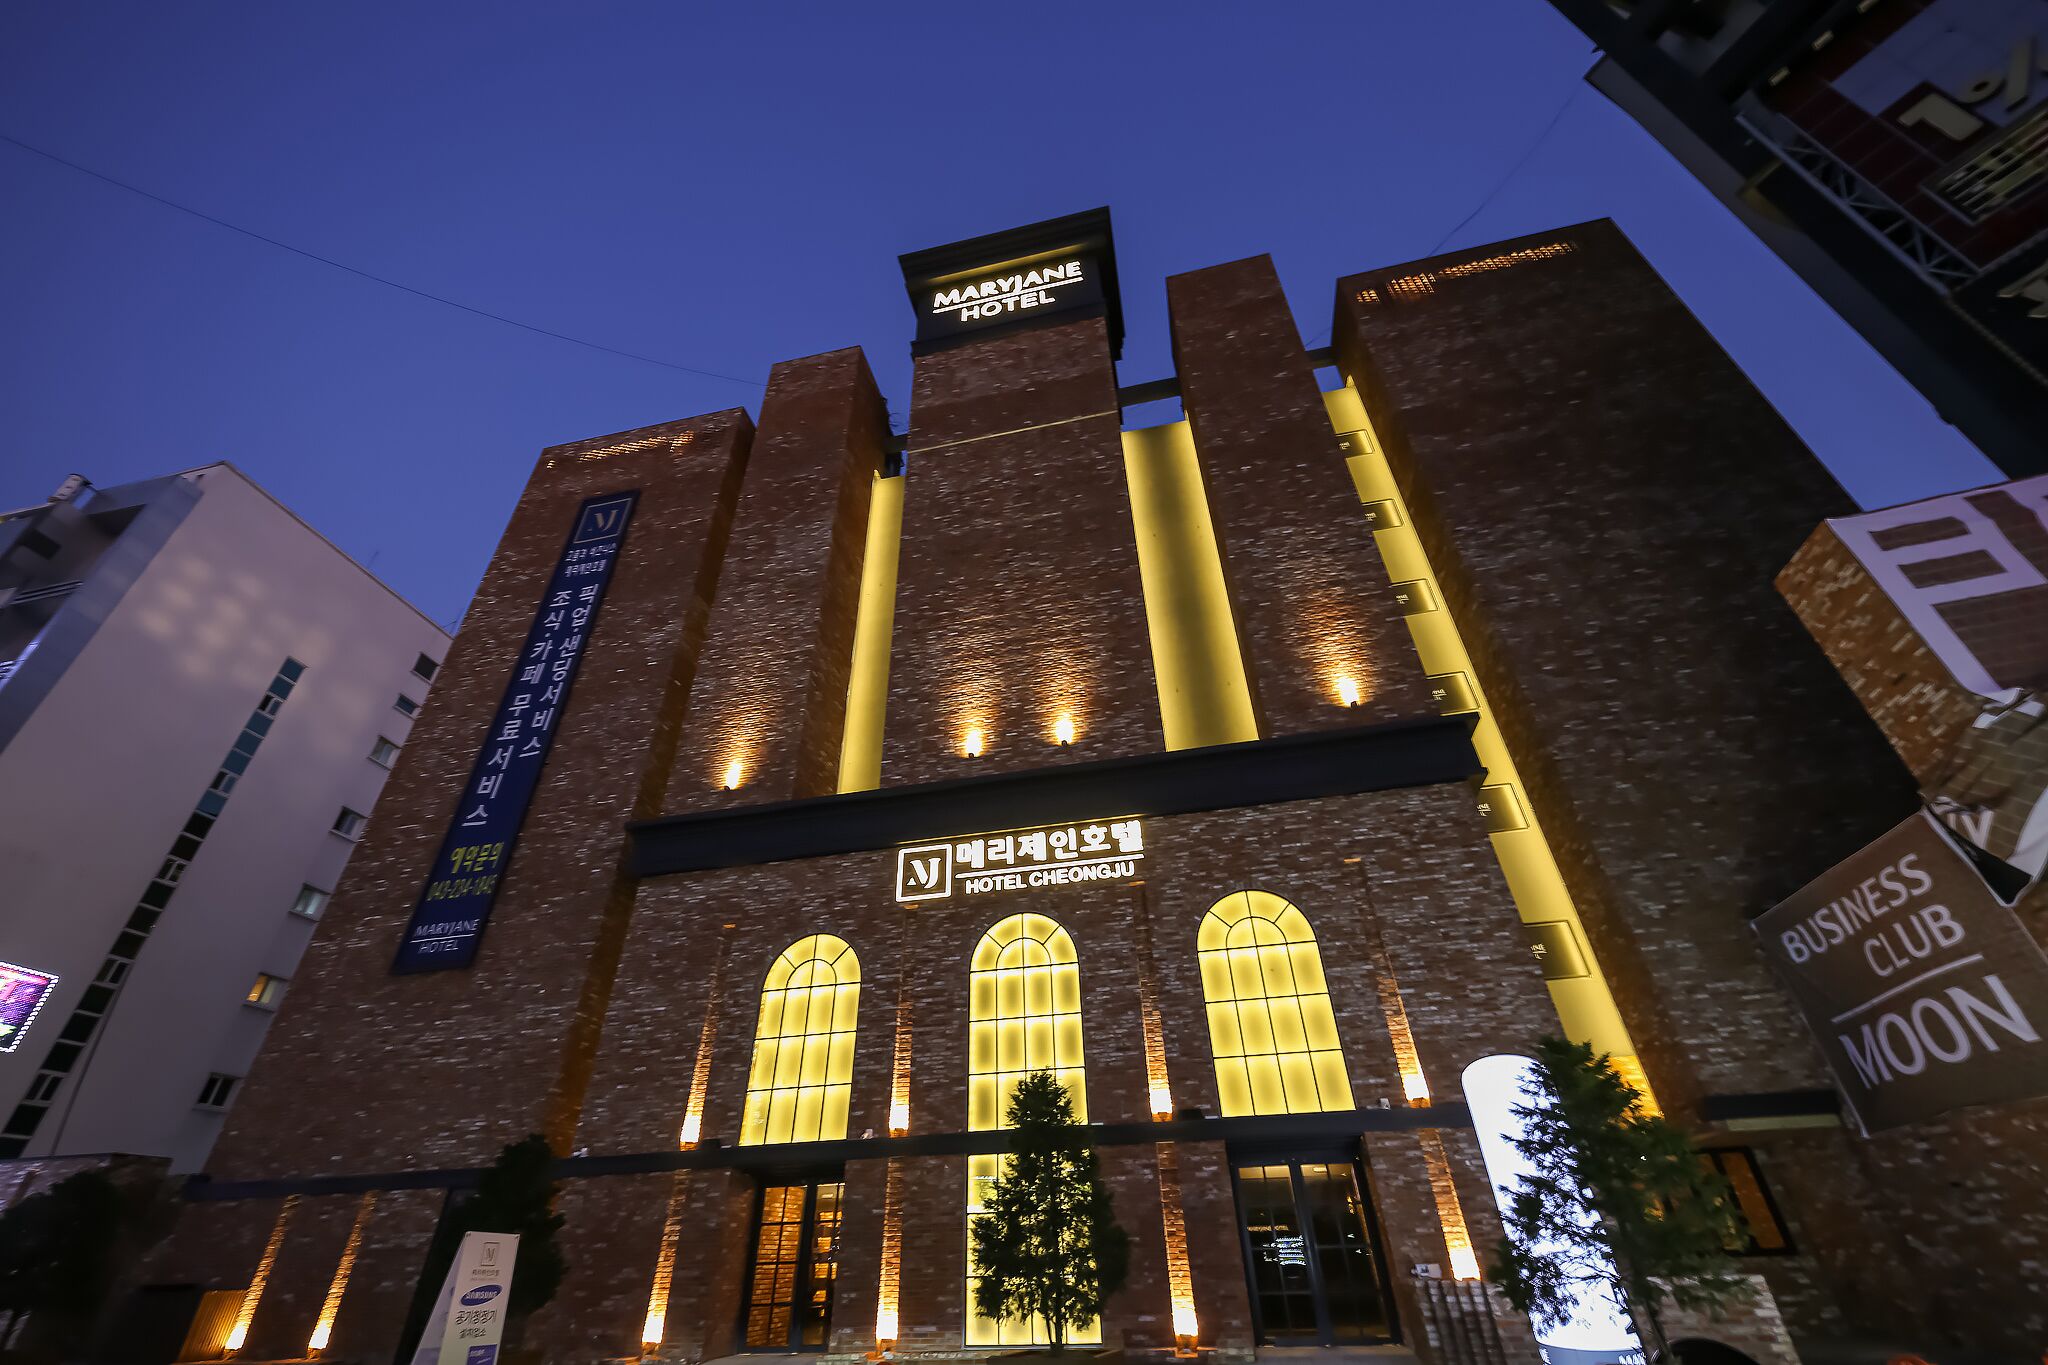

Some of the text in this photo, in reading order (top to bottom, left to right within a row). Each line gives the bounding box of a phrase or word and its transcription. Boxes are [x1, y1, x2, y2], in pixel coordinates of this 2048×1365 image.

[933, 260, 1083, 308] MARYJANE
[960, 290, 1056, 322] HOTEL
[955, 819, 1144, 869] 메리제인호텔
[964, 860, 1135, 895] HOTEL CHEONGJU
[1779, 852, 1933, 965] BUSINESS
[414, 919, 480, 937] MARYJANE
[1863, 903, 1966, 977] CLUB
[417, 939, 459, 954] HOTEL
[1837, 974, 2043, 1090] MOON
[465, 1290, 497, 1300] SAMSUNG
[455, 1309, 498, 1325] 공기청정기
